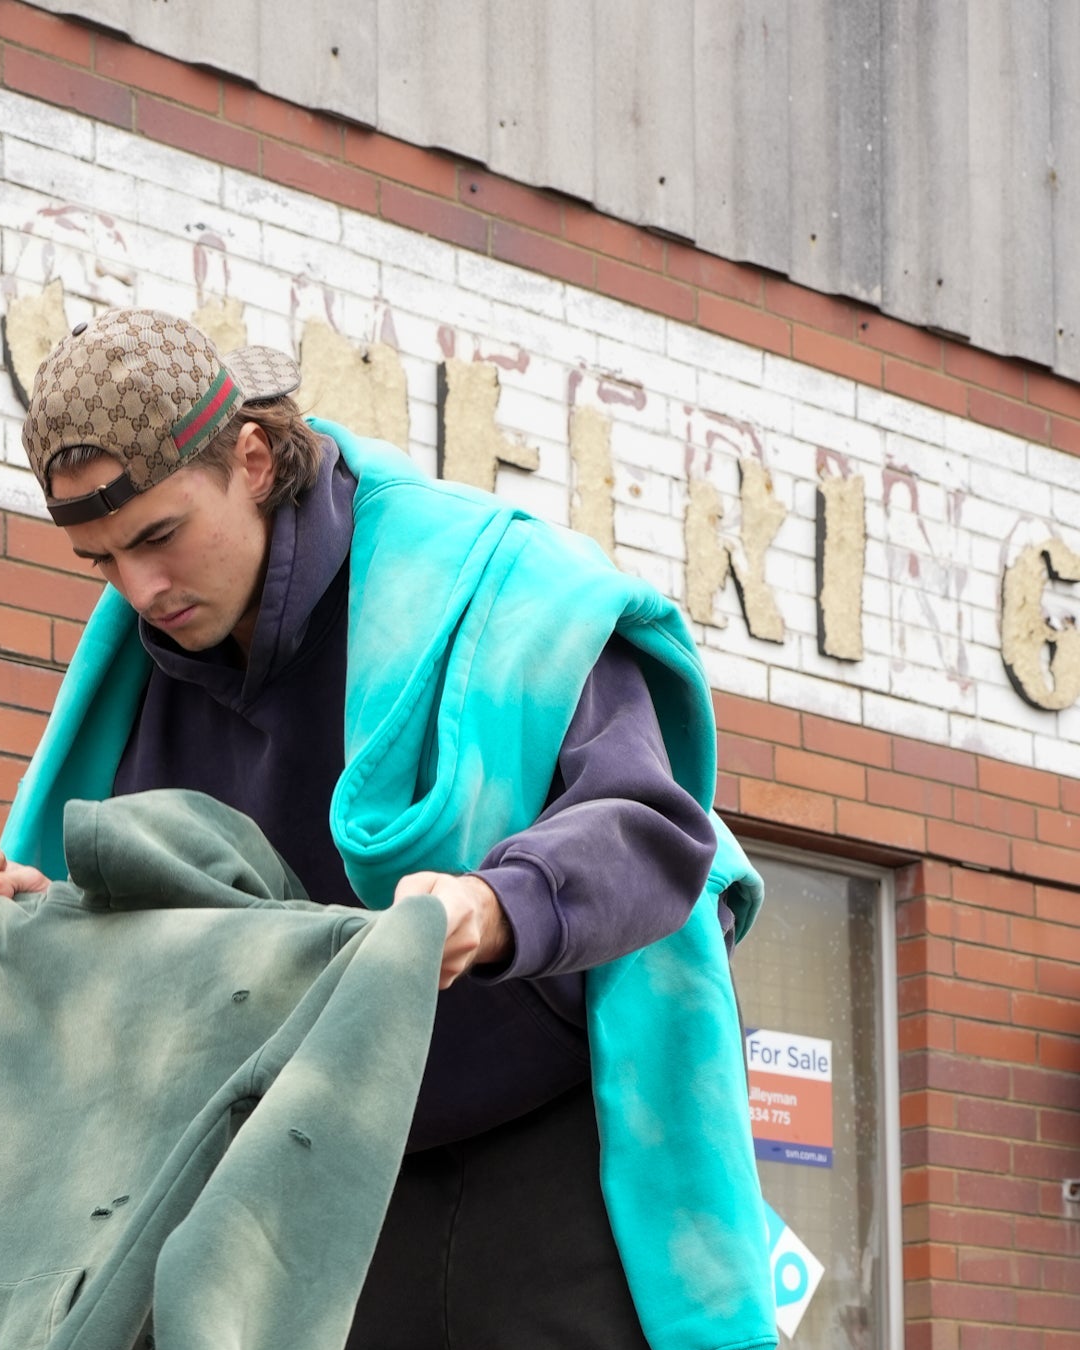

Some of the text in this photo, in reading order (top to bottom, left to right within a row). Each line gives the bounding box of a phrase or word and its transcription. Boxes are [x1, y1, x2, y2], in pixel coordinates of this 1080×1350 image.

[750, 1040, 828, 1073] For Sale
[771, 1108, 791, 1126] 775
